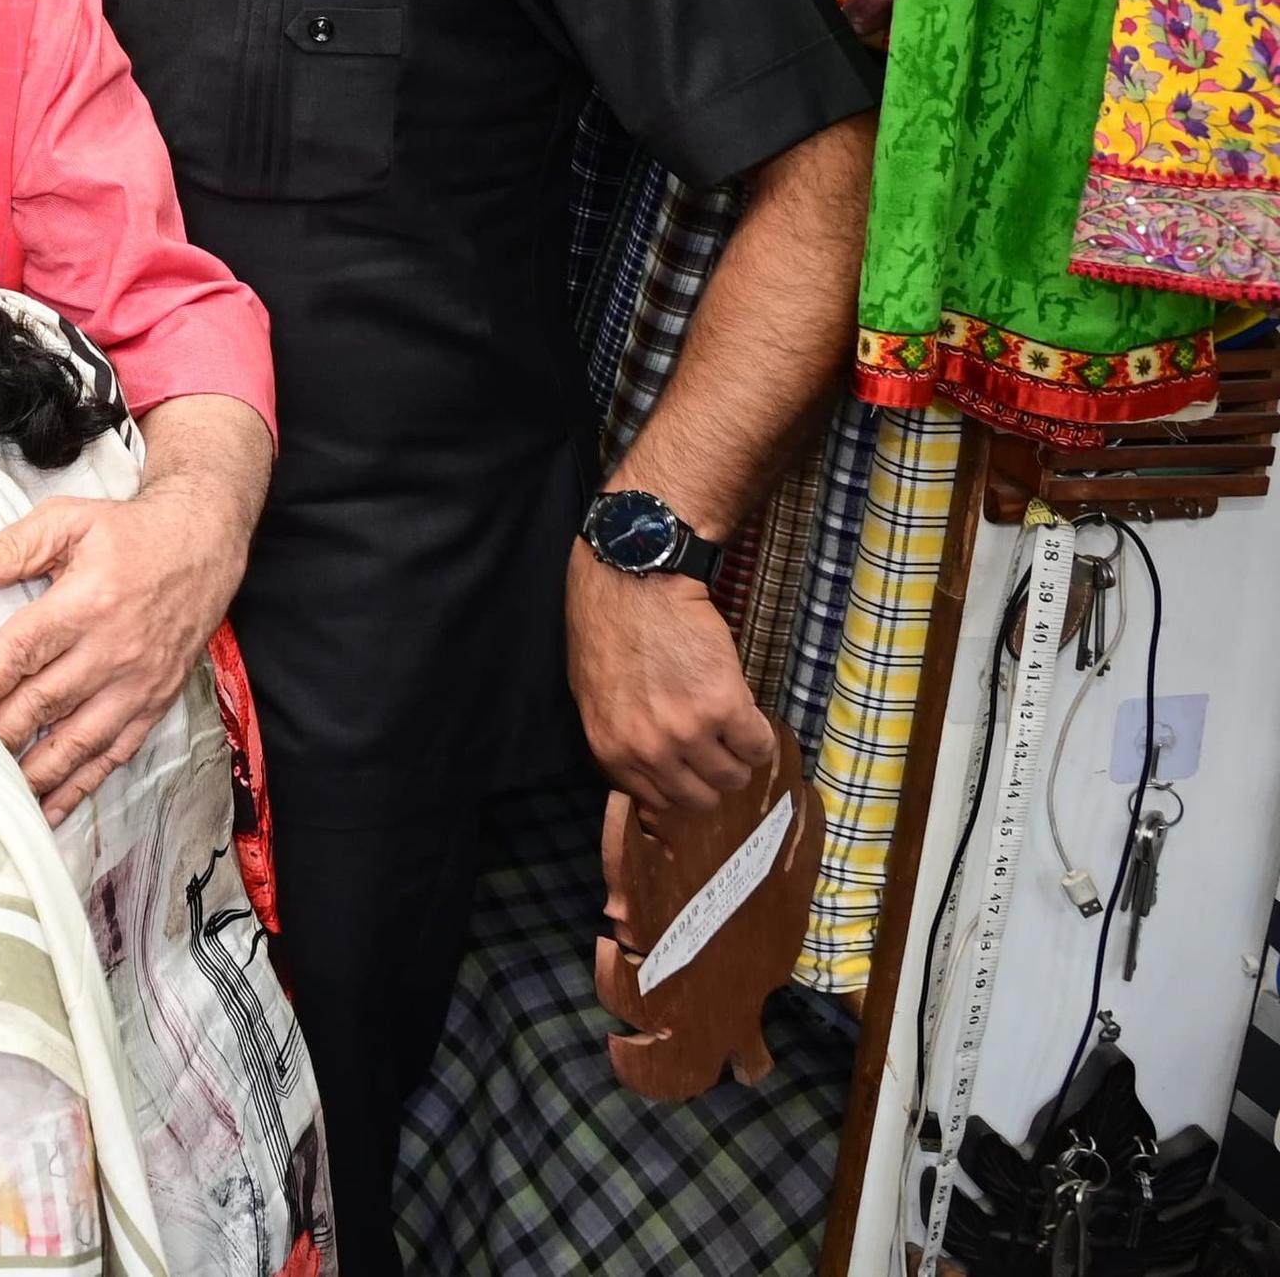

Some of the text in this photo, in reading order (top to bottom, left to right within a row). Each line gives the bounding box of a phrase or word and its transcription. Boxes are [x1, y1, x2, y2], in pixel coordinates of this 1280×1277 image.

[1044, 539, 1060, 562] 38
[1039, 581, 1055, 603] 39
[1032, 621, 1050, 643] 40
[1027, 659, 1043, 681] 41
[1020, 699, 1035, 720] 42
[1014, 740, 1029, 759] 43
[1007, 778, 1023, 799] 44
[1000, 816, 1015, 837] 45
[994, 855, 1009, 877] 46
[653, 904, 700, 966] PANDIT
[705, 860, 741, 901] WOOD
[988, 893, 1003, 915] 47
[980, 929, 995, 951] 48
[975, 967, 989, 989] 49
[968, 1005, 982, 1026] 50
[956, 1078, 969, 1097] 52
